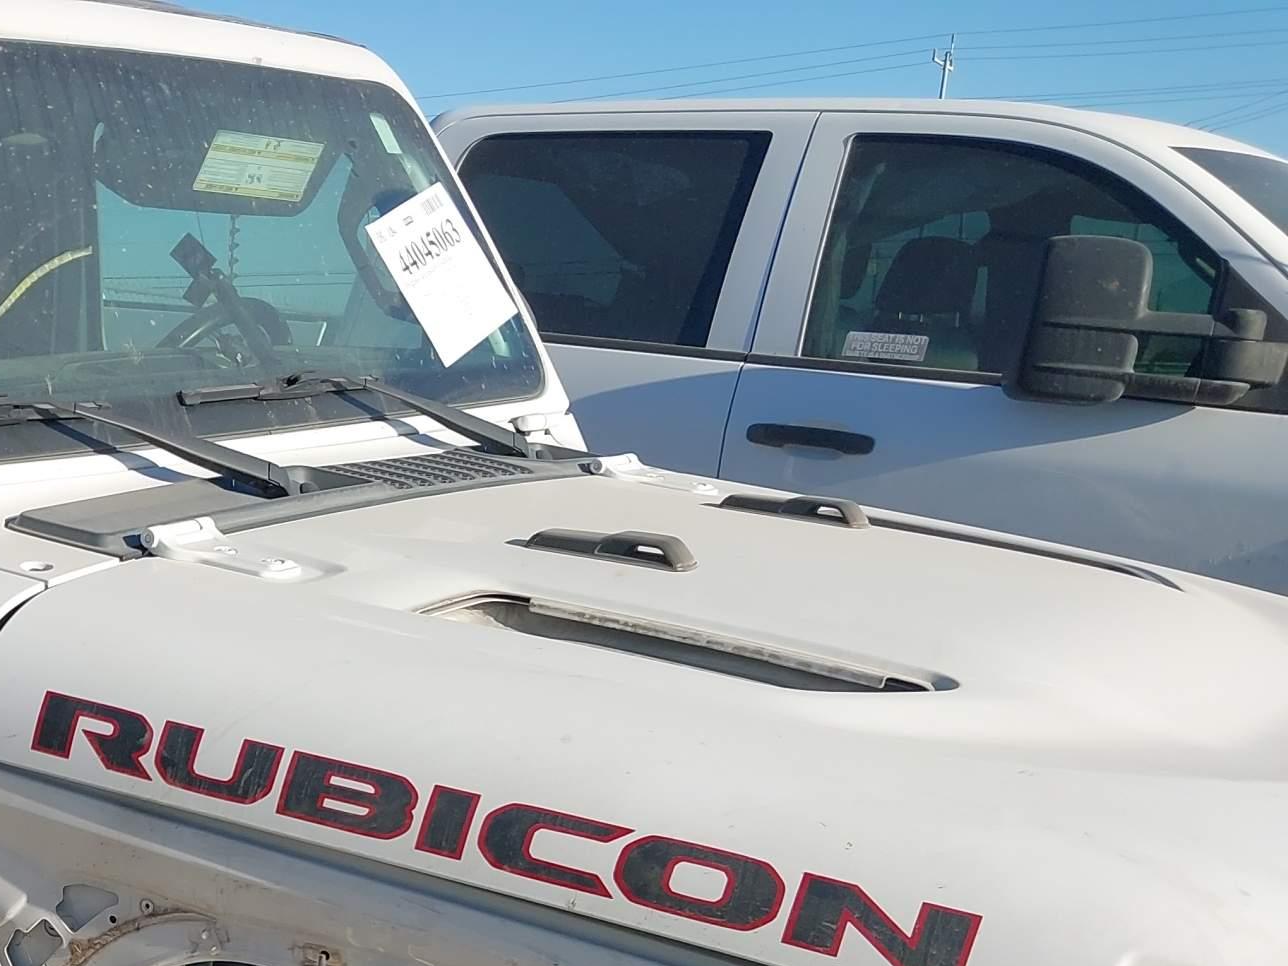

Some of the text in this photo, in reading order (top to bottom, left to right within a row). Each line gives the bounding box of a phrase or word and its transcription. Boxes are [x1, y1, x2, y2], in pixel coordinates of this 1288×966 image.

[399, 218, 462, 275] 44045063
[871, 335, 894, 343] SEAT
[906, 336, 928, 345] NOT
[851, 342, 871, 351] FOR
[872, 342, 918, 354] SLEEPING
